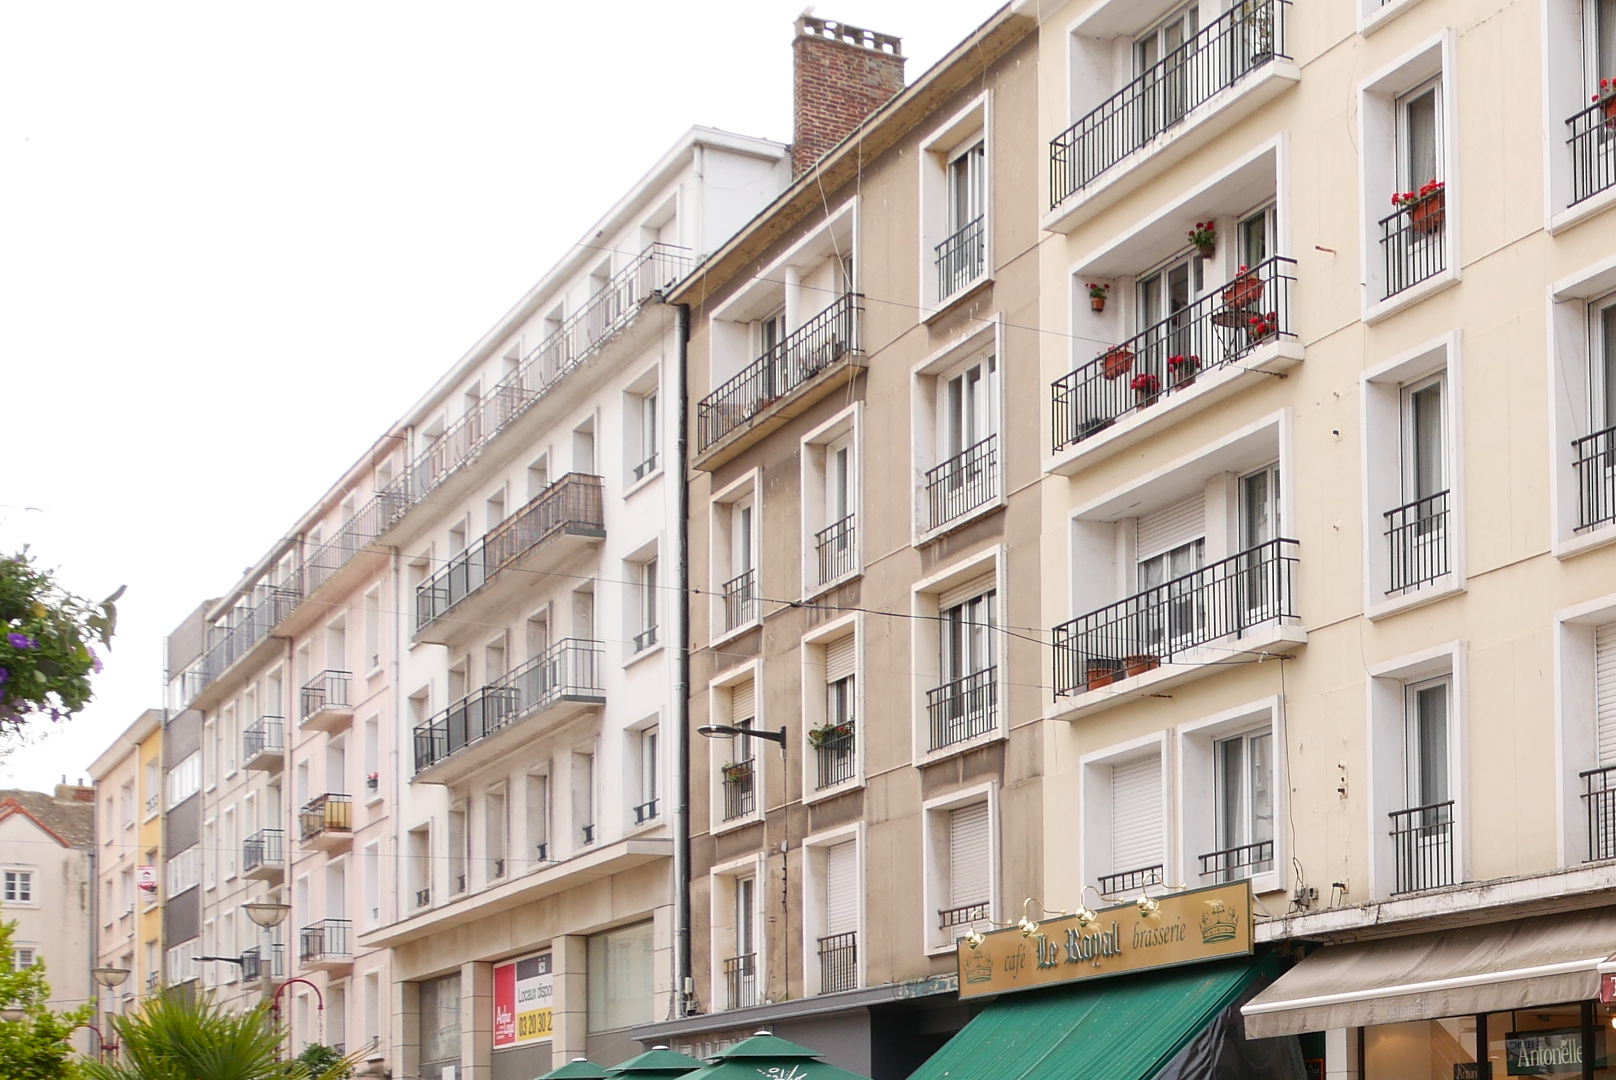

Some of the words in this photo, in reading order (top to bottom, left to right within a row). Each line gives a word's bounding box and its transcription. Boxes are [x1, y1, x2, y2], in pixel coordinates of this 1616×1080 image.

[1004, 943, 1026, 978] café
[1036, 933, 1058, 970] Le
[1064, 920, 1121, 967] Royal
[1132, 916, 1186, 950] brasserie
[518, 987, 538, 1003] Locaux
[519, 1015, 527, 1036] 03
[528, 1014, 537, 1034] 20
[538, 1012, 546, 1033] 30
[1517, 1038, 1583, 1068] Antonelle
[1455, 1066, 1478, 1080] Anton
